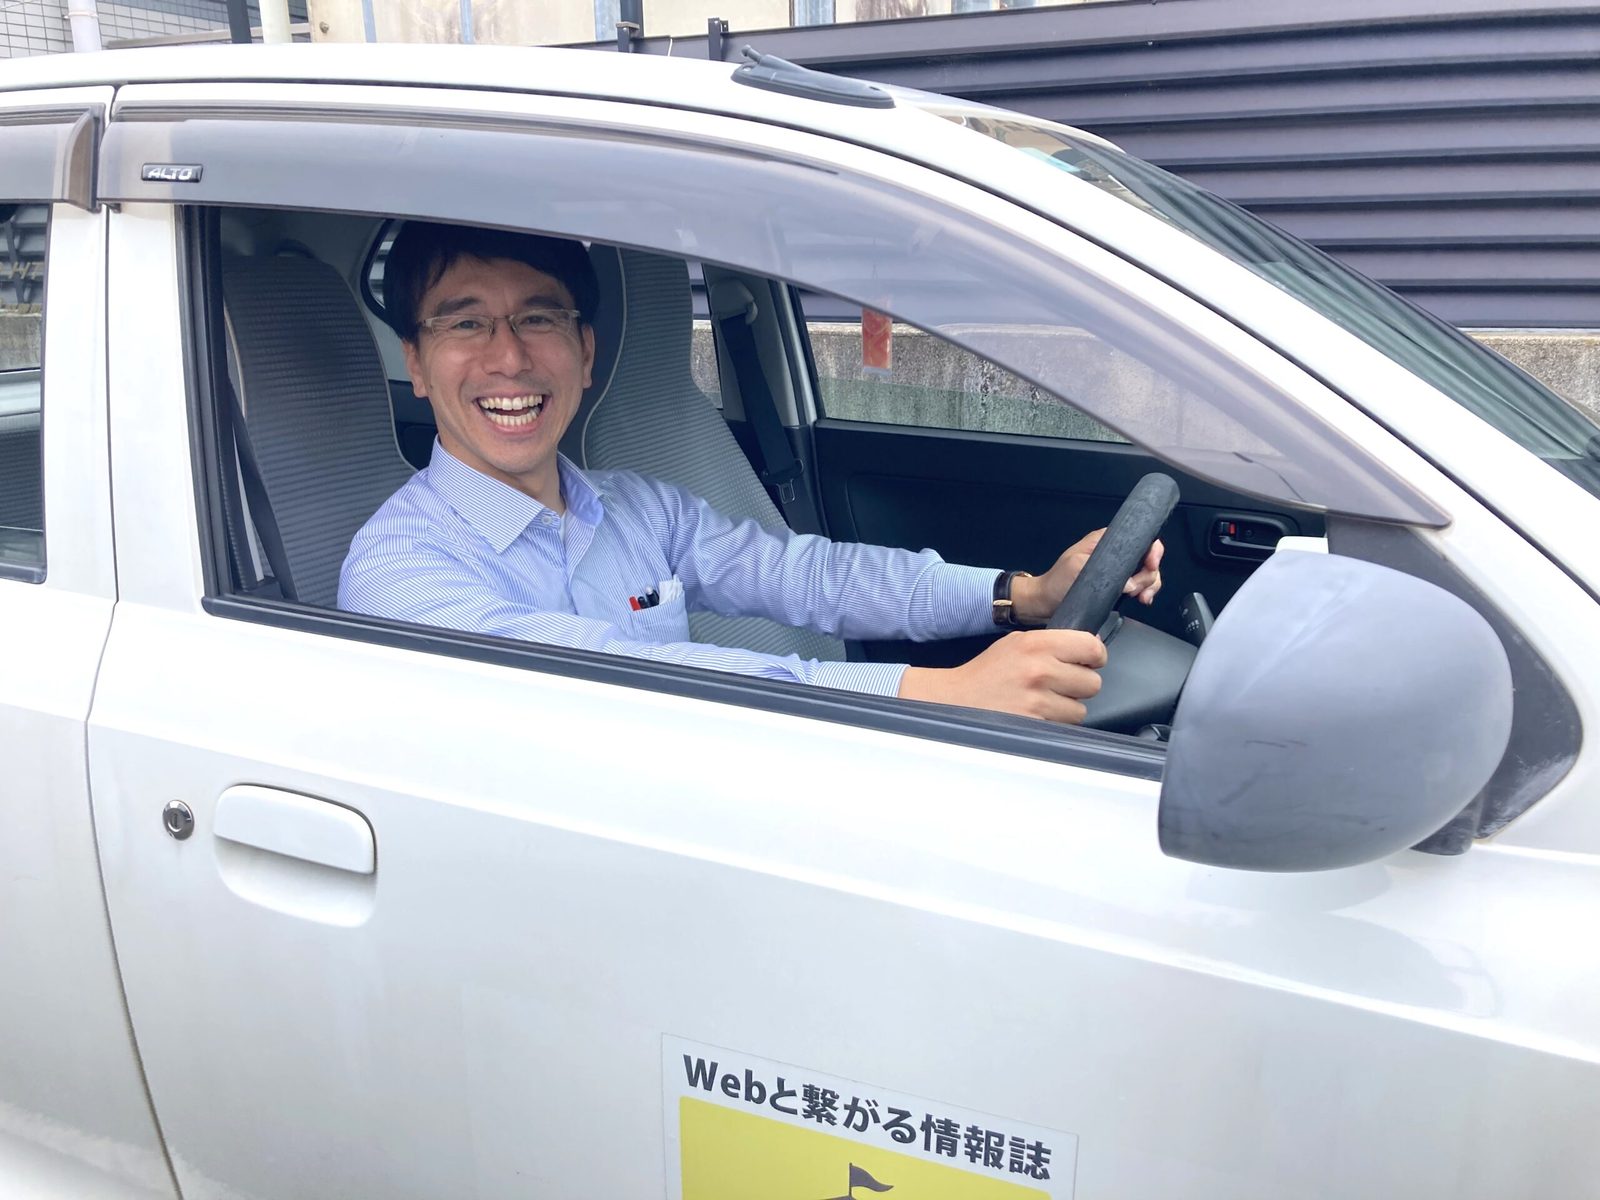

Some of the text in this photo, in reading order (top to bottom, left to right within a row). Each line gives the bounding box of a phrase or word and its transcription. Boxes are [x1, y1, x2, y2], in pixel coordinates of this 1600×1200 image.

[147, 167, 193, 181] ALTO
[683, 1054, 1052, 1180] Webと繋がる情報誌
